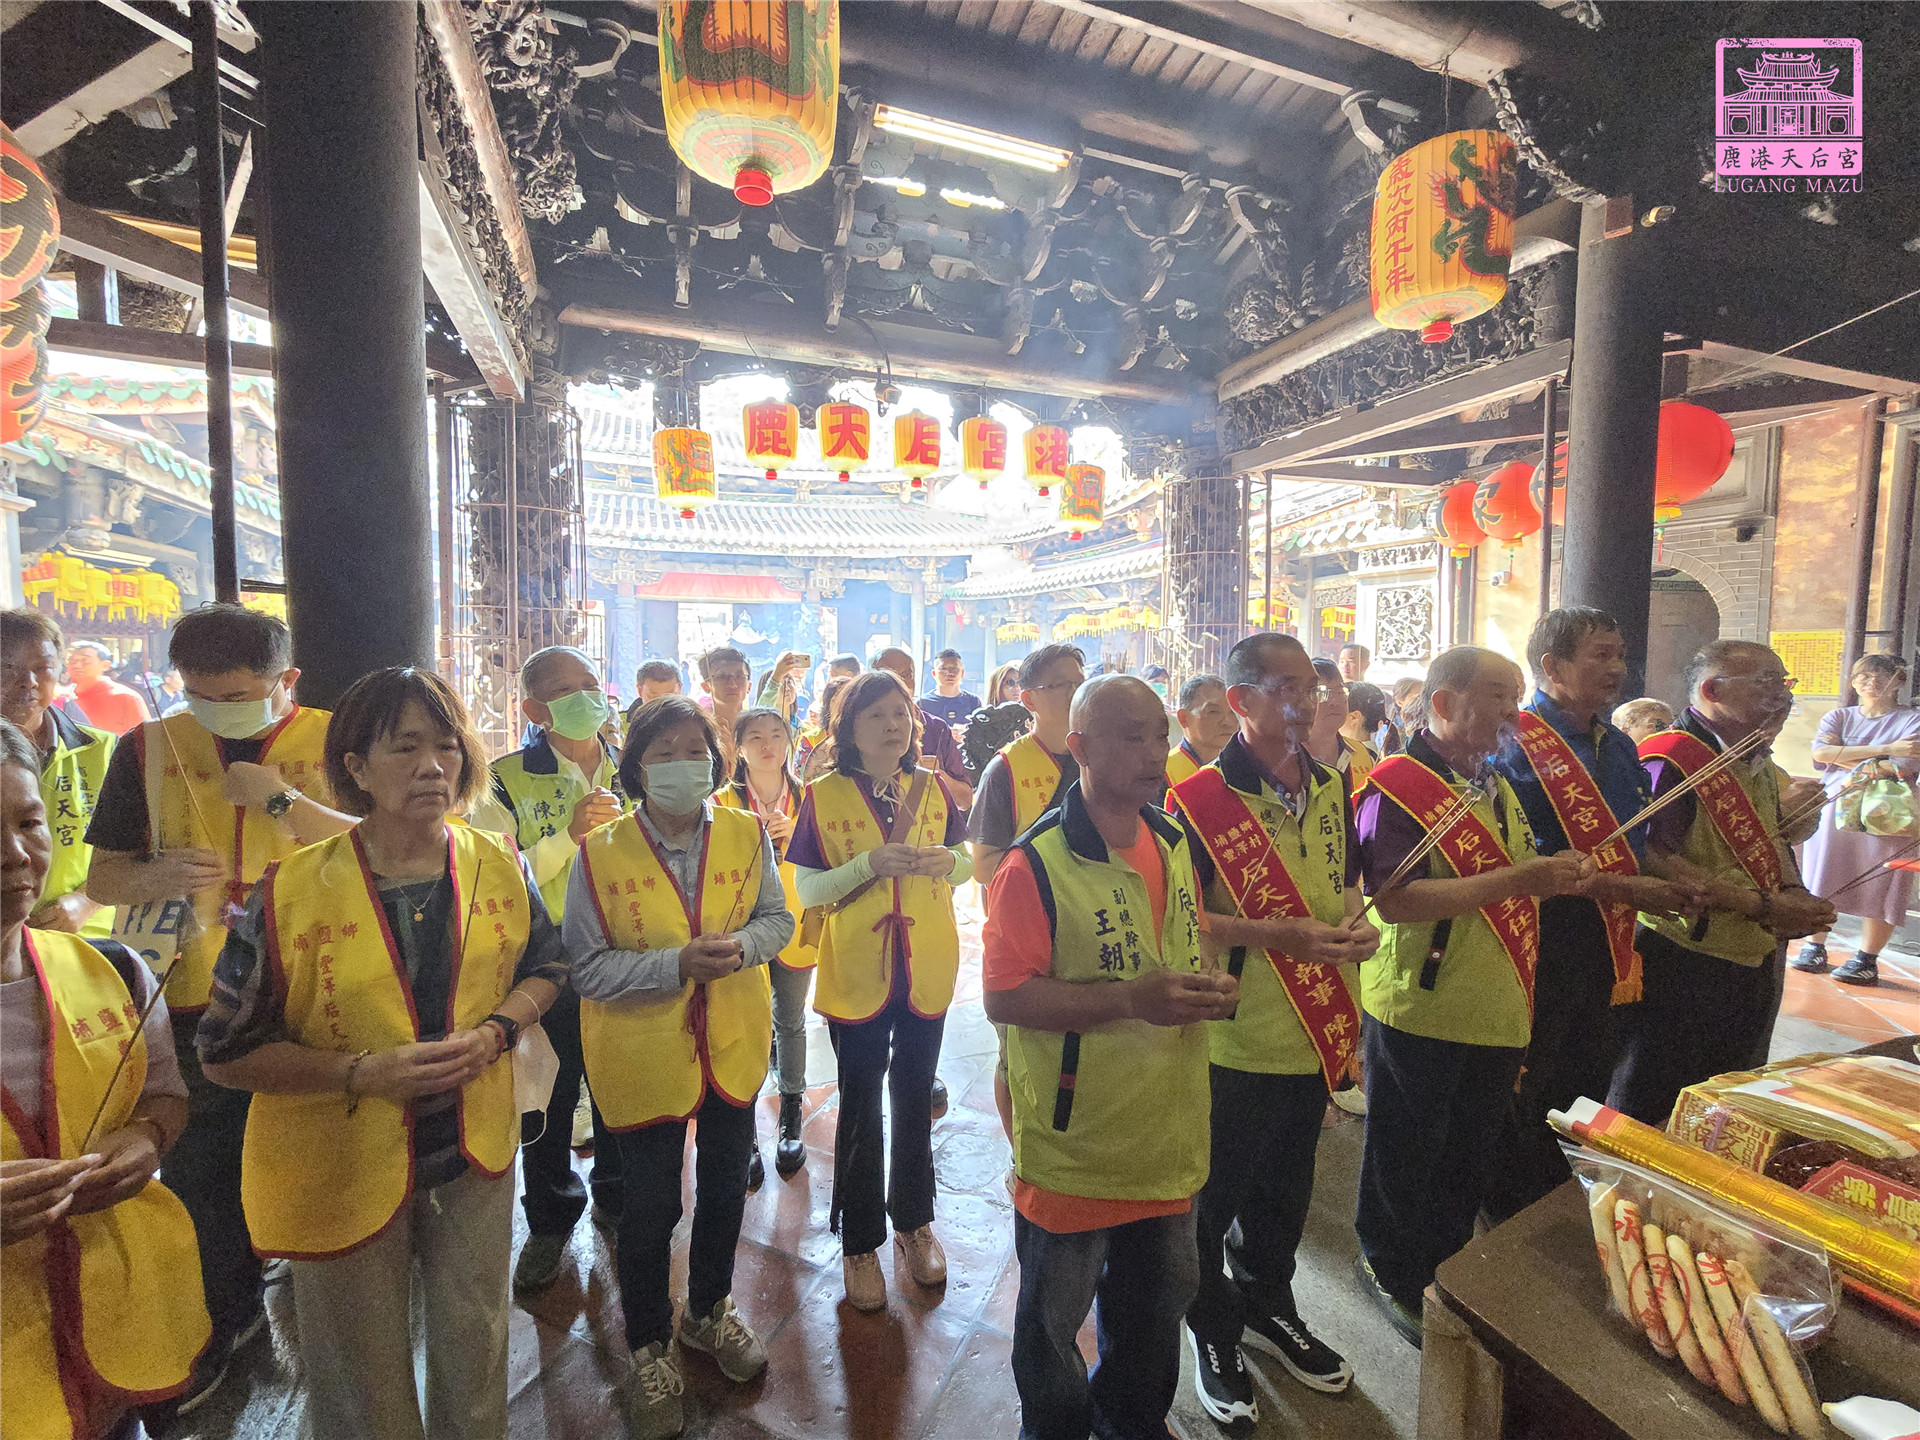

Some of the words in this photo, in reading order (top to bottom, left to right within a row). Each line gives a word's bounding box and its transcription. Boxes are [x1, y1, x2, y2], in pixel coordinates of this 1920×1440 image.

[747, 404, 792, 458] 鹿
[826, 404, 870, 460] 天
[903, 417, 941, 466] 后
[977, 422, 1008, 472] 宮
[1035, 430, 1069, 477] 港
[55, 775, 80, 847] 后天宮
[1543, 753, 1600, 834] 后天宮
[1319, 814, 1343, 895] 后天宮
[1094, 908, 1125, 982] 王朝
[1112, 887, 1141, 972] 副總幹事
